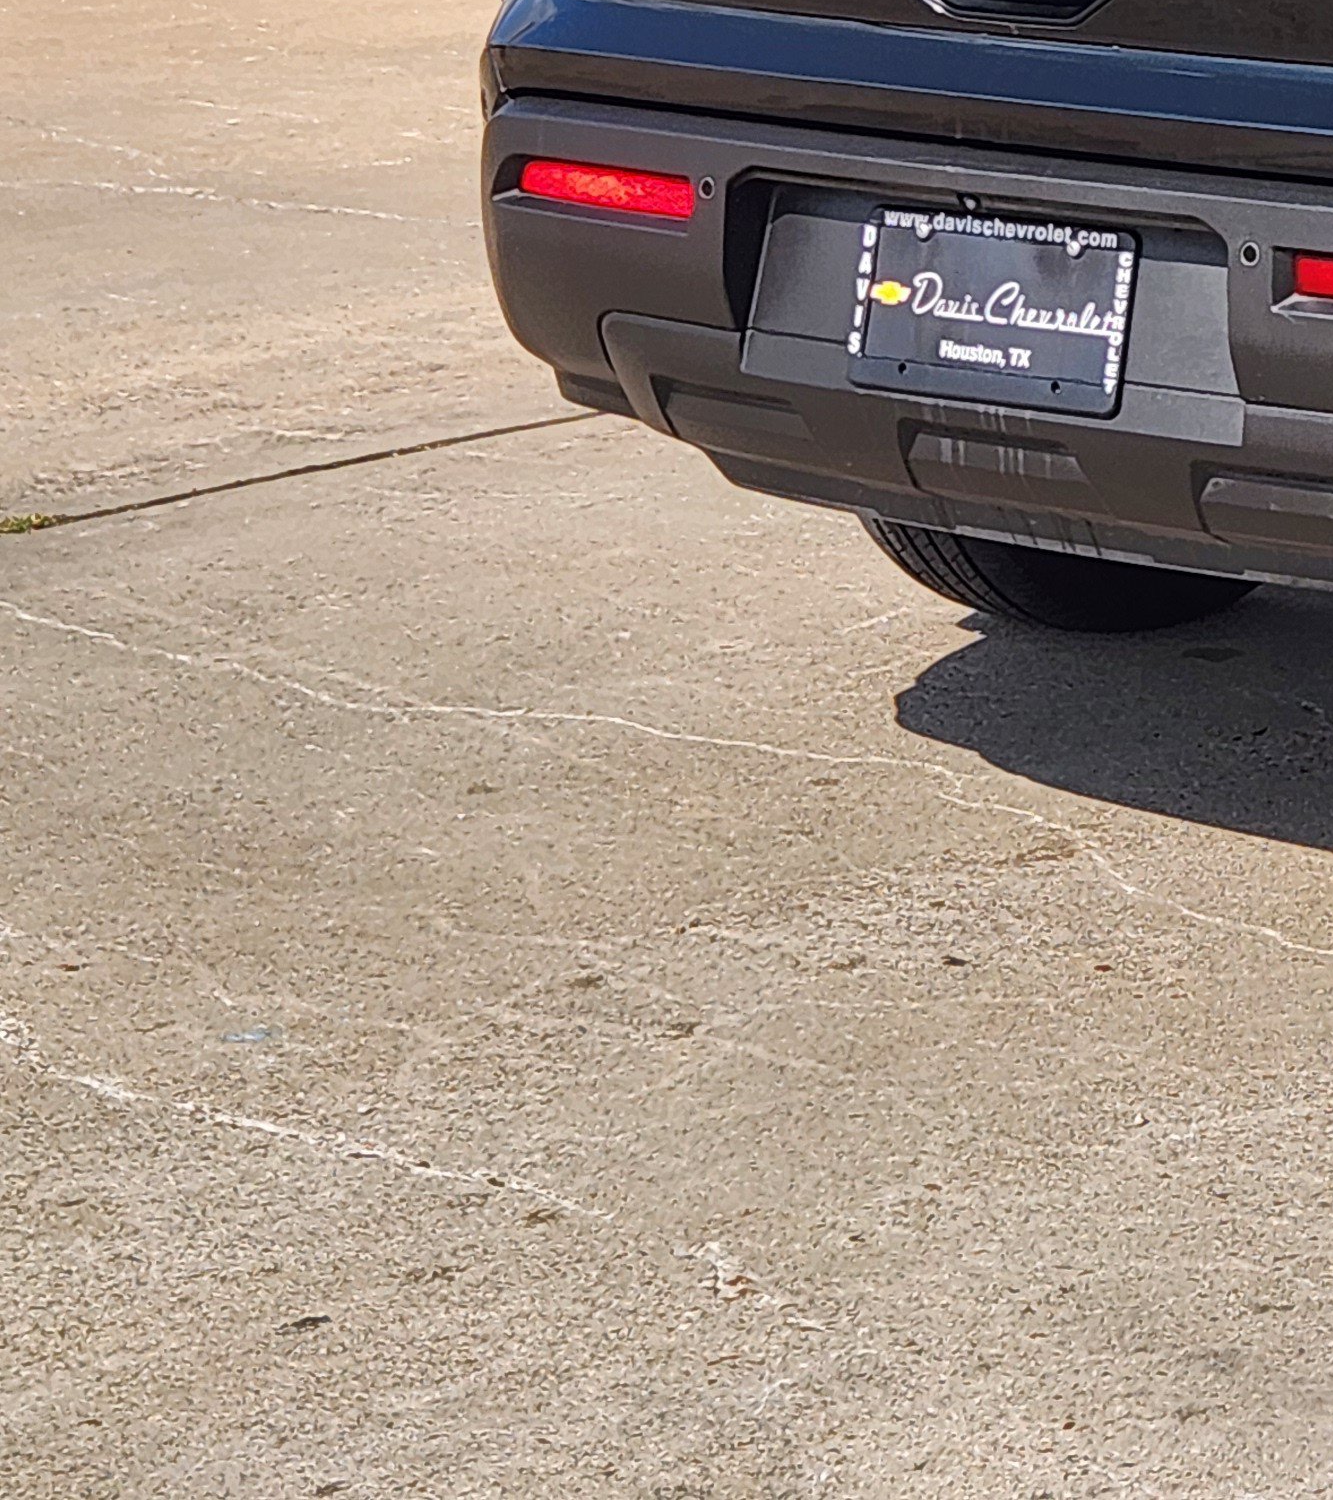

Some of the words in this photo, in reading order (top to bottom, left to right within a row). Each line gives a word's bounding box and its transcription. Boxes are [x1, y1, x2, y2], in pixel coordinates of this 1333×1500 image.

[884, 209, 1118, 250] www.davischevrolet.com
[847, 223, 878, 355] DAVIS
[912, 270, 984, 321] Davis
[983, 281, 1117, 337] Chevrolet
[1103, 250, 1134, 395] CHEVROLET
[938, 338, 1006, 370] Houston,
[1008, 347, 1032, 369] TX
